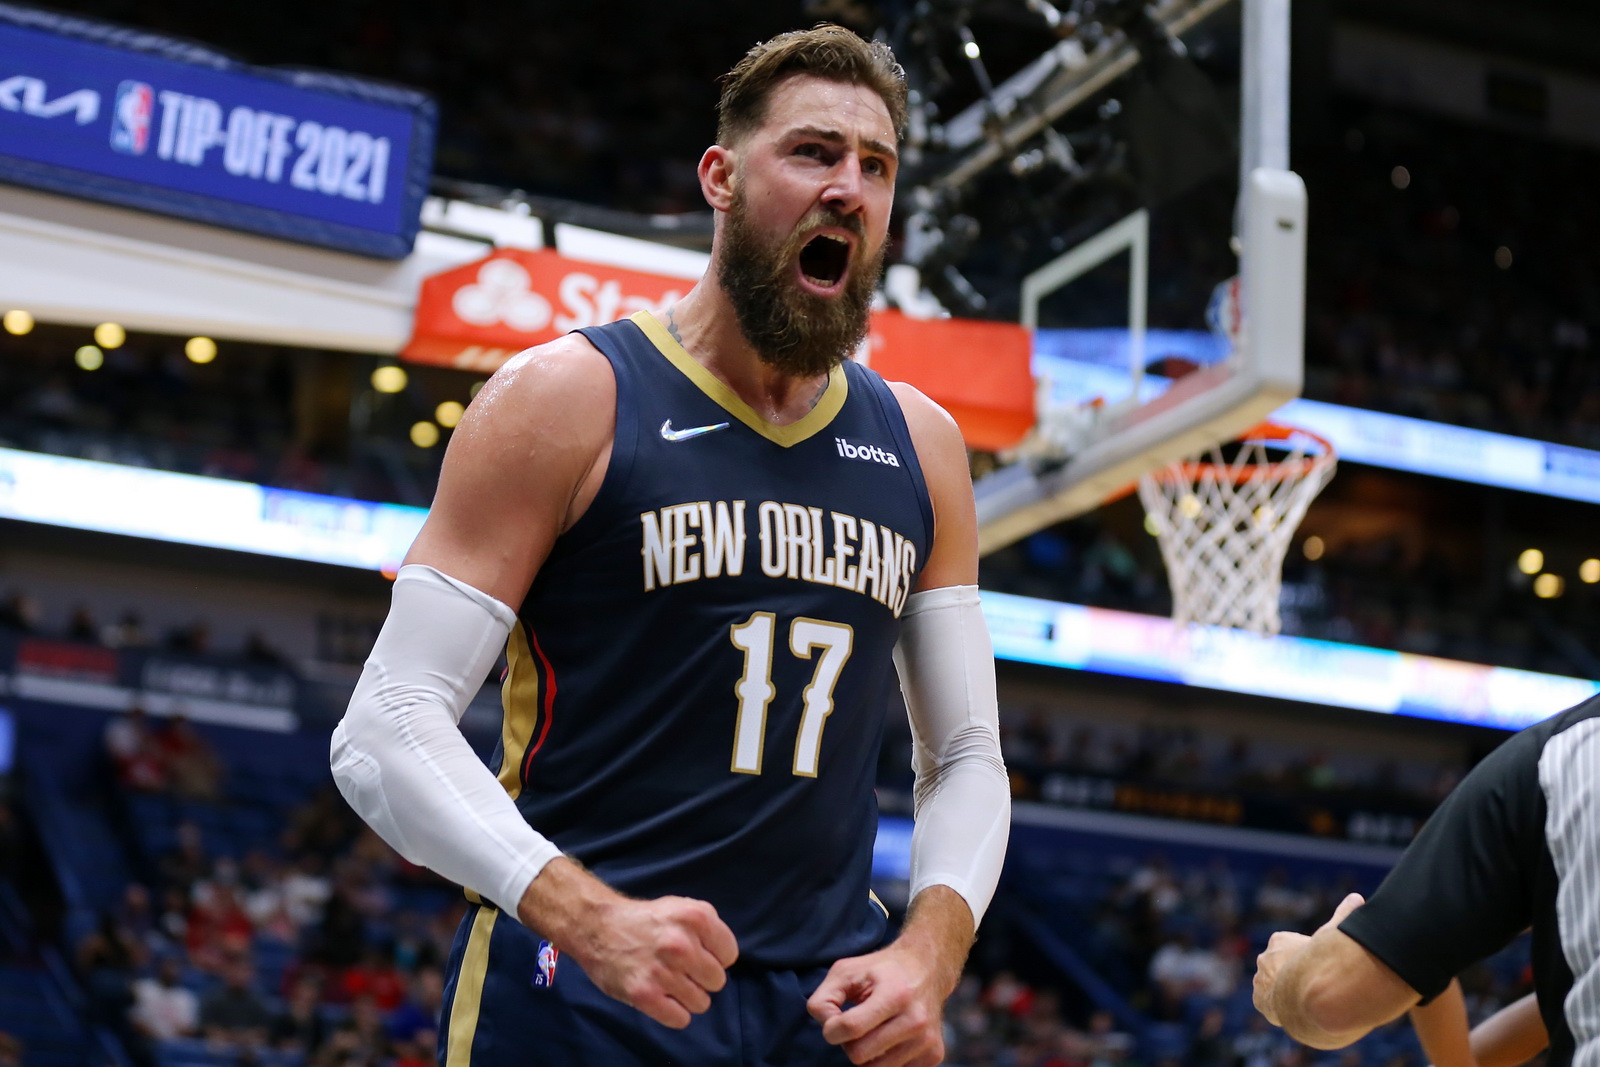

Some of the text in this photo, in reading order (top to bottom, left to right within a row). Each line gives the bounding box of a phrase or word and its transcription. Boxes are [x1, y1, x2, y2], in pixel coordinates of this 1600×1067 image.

[157, 89, 391, 204] TIP-OFF 2021
[835, 437, 900, 468] ibotta
[640, 500, 917, 619] NEW ORLEANS
[730, 611, 854, 778] 17
